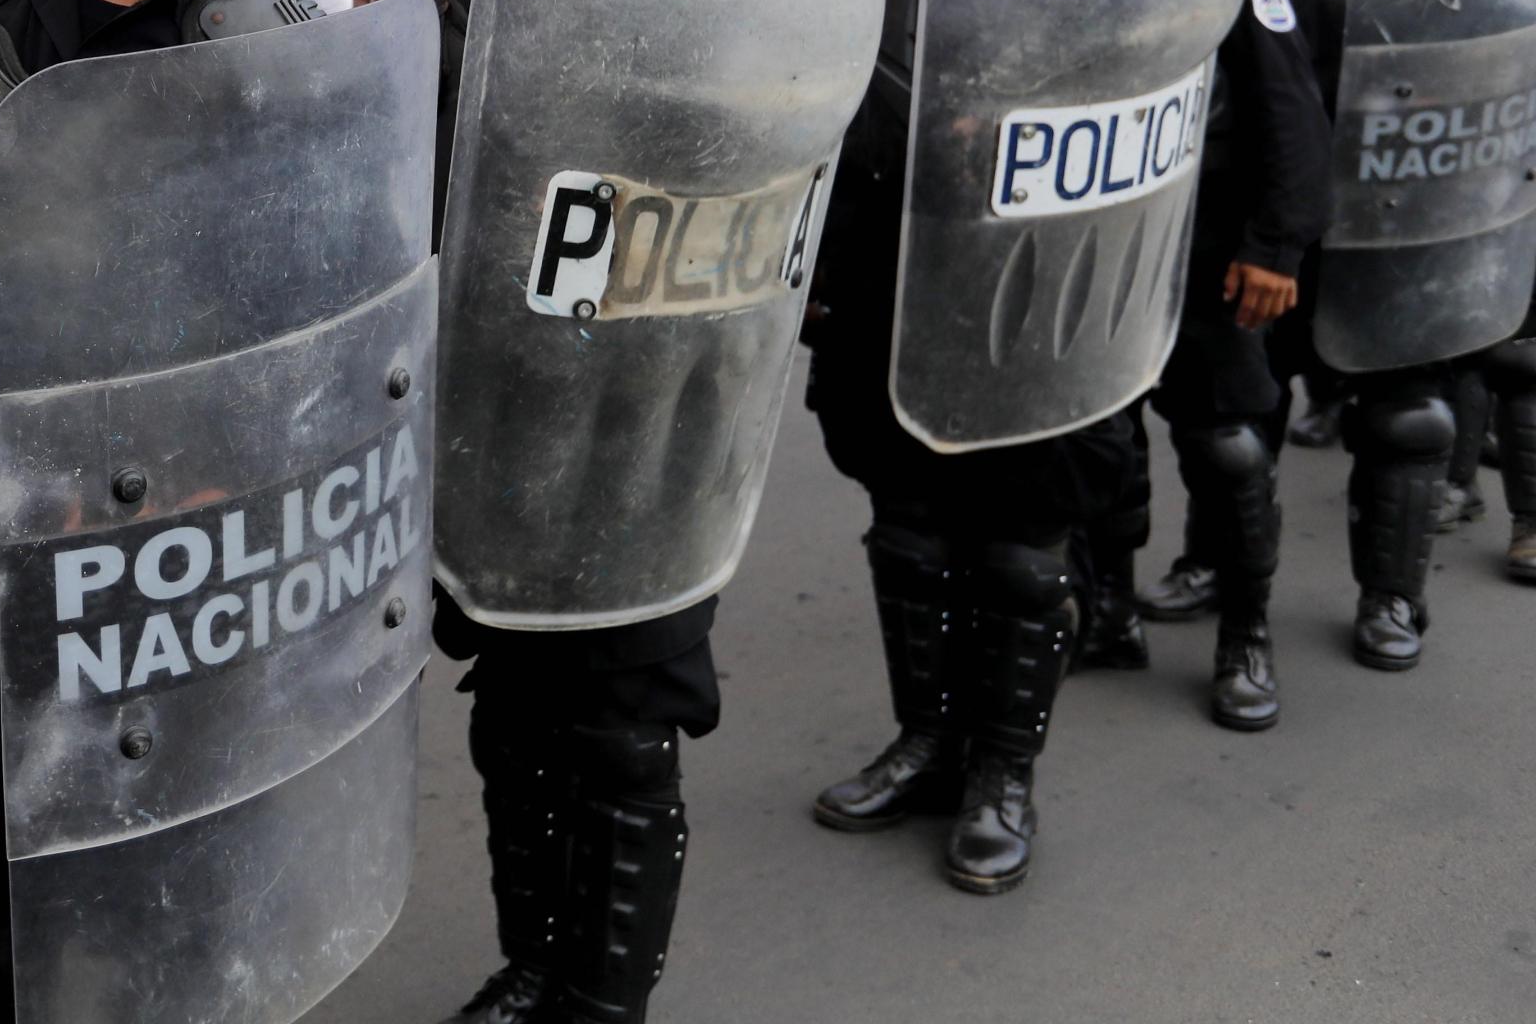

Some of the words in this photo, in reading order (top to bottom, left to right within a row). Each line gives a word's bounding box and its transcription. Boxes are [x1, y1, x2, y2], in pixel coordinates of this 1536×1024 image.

[1357, 121, 1536, 182] NACION
[1361, 88, 1536, 146] POLICI
[53, 423, 419, 622] POLICIA
[56, 494, 421, 702] NACIONAL
